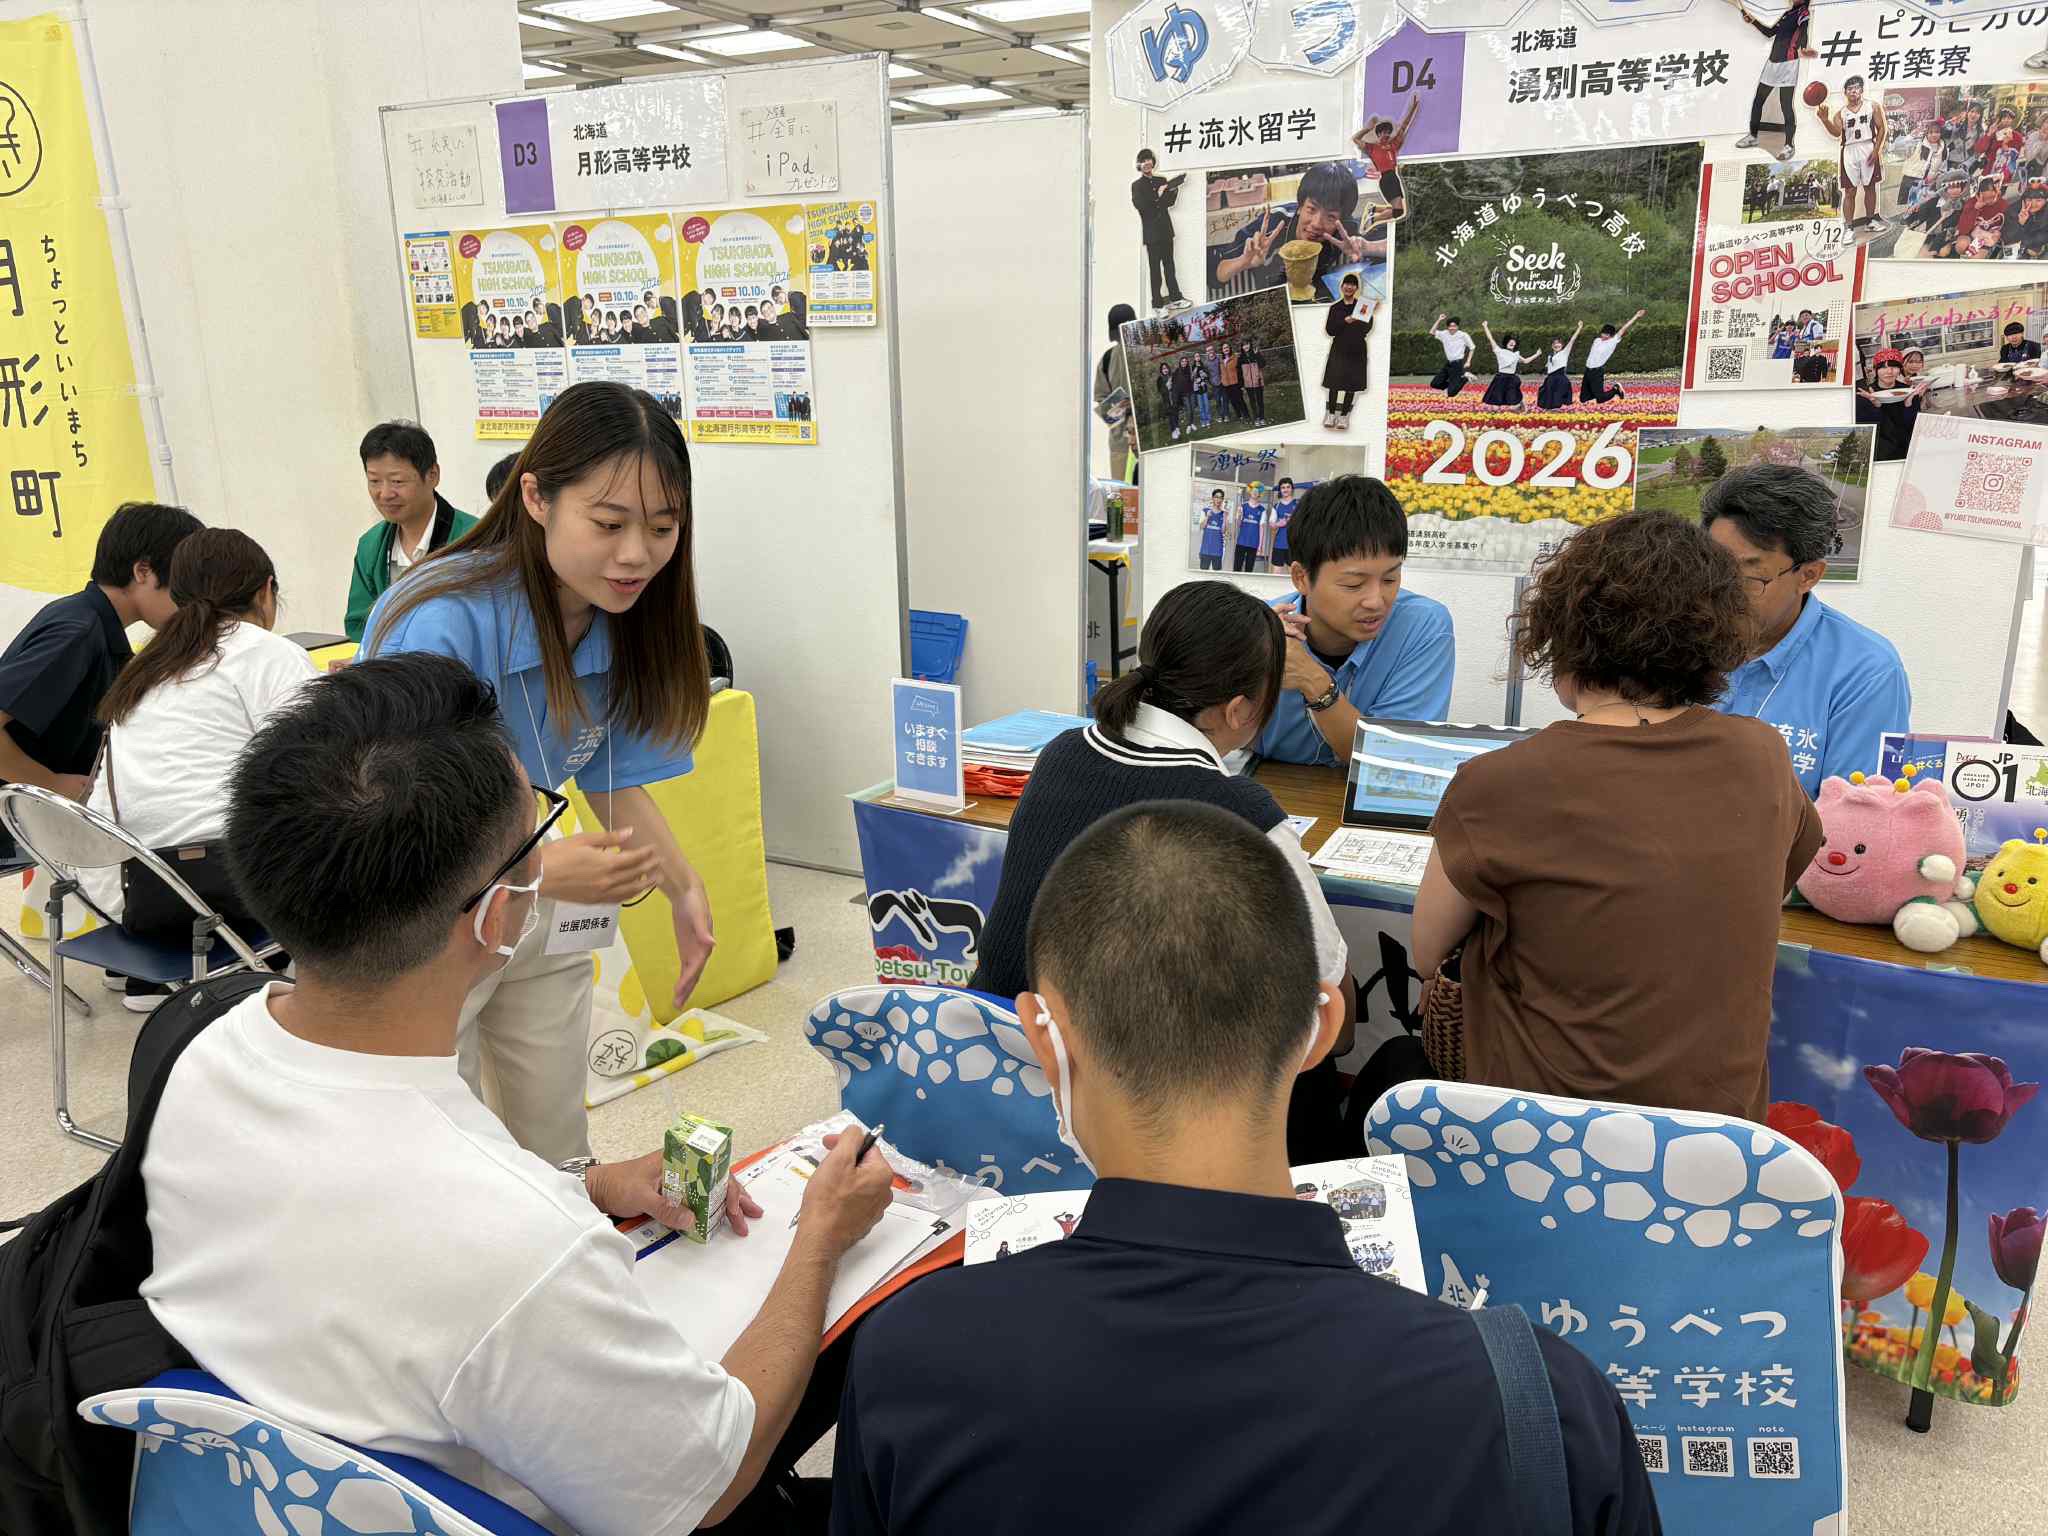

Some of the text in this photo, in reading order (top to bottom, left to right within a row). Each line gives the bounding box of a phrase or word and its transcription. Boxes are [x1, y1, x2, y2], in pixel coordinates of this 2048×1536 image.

[1511, 26, 1577, 54] 北海道
[1392, 57, 1436, 94] D4
[1507, 49, 1730, 103] 湧別高等学校
[1868, 45, 1971, 82] 新築寮
[574, 122, 608, 140] 北海道
[1164, 108, 1316, 153] #流氷留学
[513, 141, 537, 167] D3
[576, 144, 692, 177] 月形高等学校
[1435, 187, 1646, 268] 北海道ゆうべつ高校
[1709, 223, 1804, 251] 北海道ゆうべつ高等学校
[1506, 242, 1566, 271] Seek
[1710, 242, 1794, 278] OPEN
[1506, 274, 1564, 293] Yourself
[1712, 260, 1844, 303] SCHOOL
[41, 235, 88, 467] ちょっといいまち
[1422, 420, 1633, 489] 2026
[1967, 433, 2042, 450] INSTAGRAM
[904, 721, 948, 740] いますぐ
[904, 751, 948, 768] できます
[559, 916, 610, 933] 出展関係者
[1541, 1298, 1787, 1348] ゆうべつ
[1677, 1424, 1735, 1433] Instagram
[1758, 1425, 1785, 1433] note
